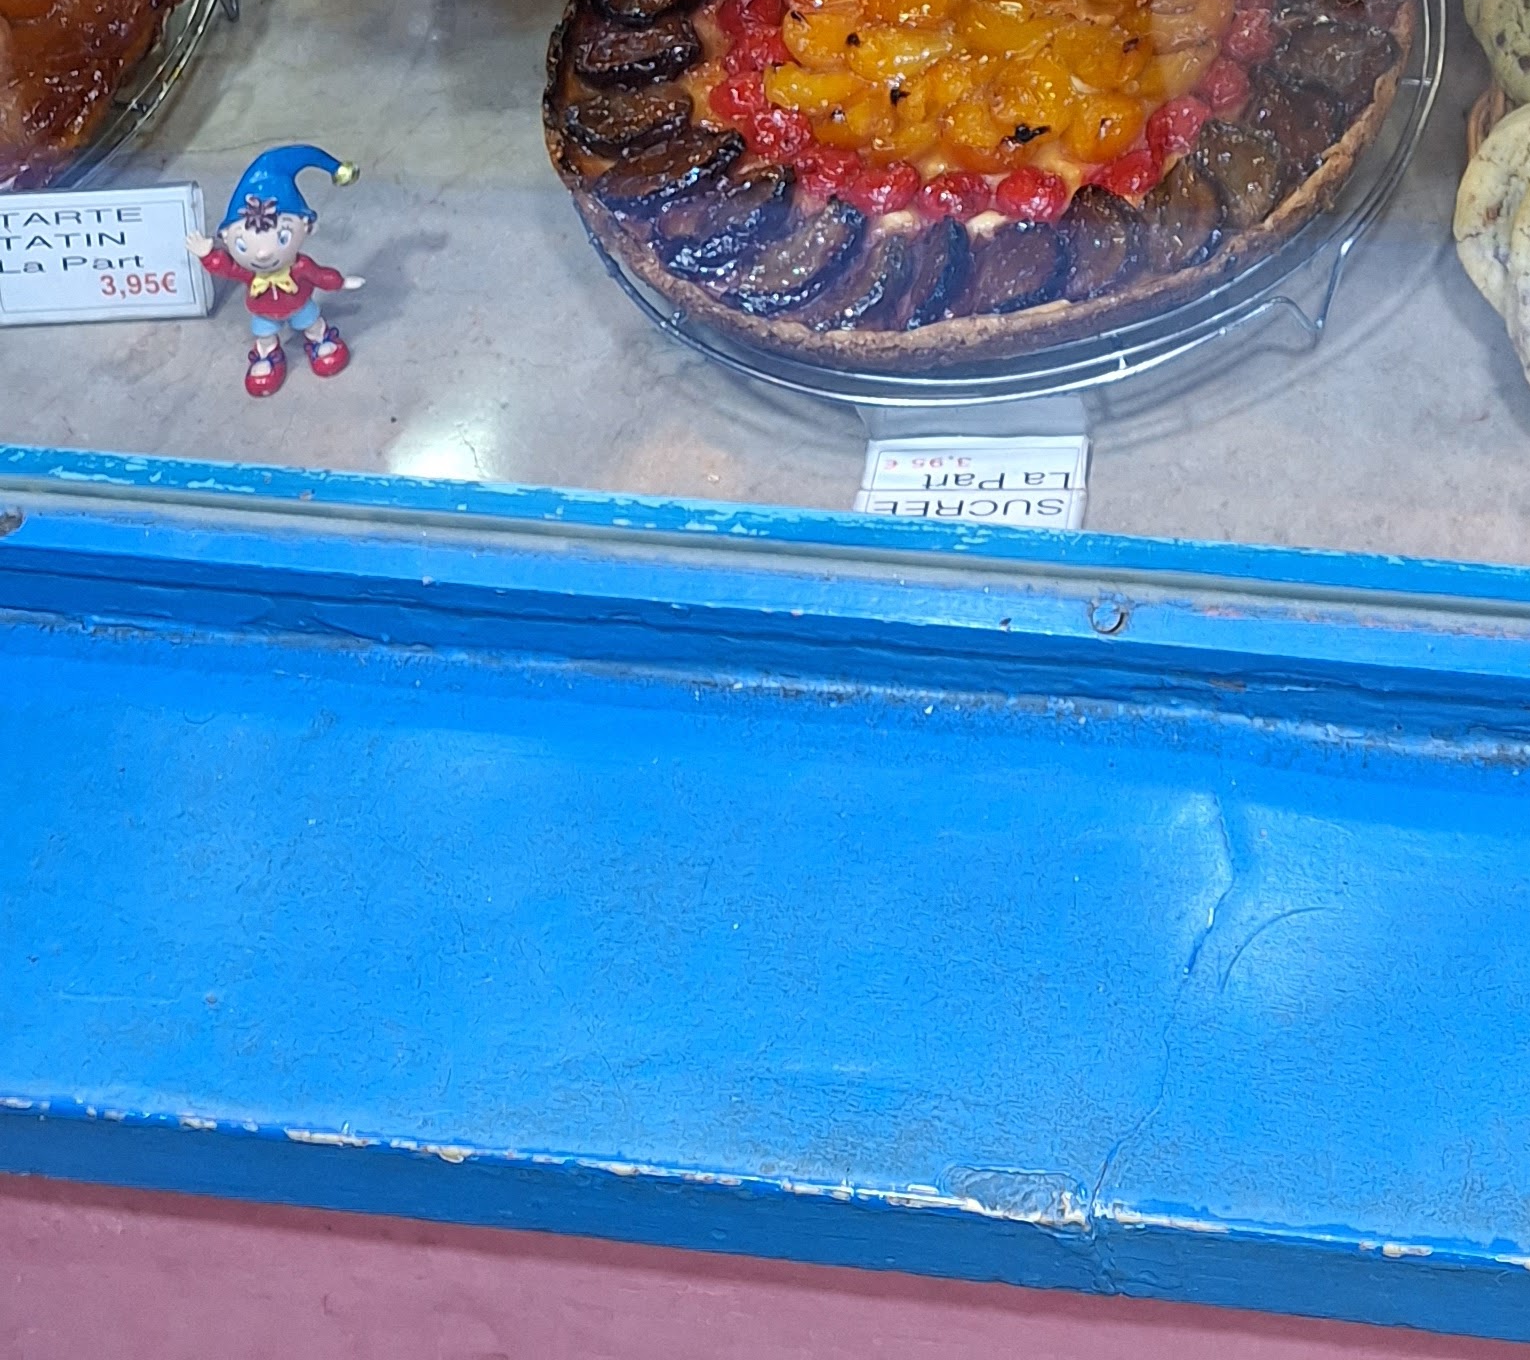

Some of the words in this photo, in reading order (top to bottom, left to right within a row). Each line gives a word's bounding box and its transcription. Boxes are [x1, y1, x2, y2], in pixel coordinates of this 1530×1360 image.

[0, 207, 143, 230] TARTE
[0, 231, 127, 251] TATIN
[62, 254, 145, 271] Part
[100, 271, 178, 300] 3,95€
[924, 472, 1006, 490] Part
[1024, 472, 1071, 490] La
